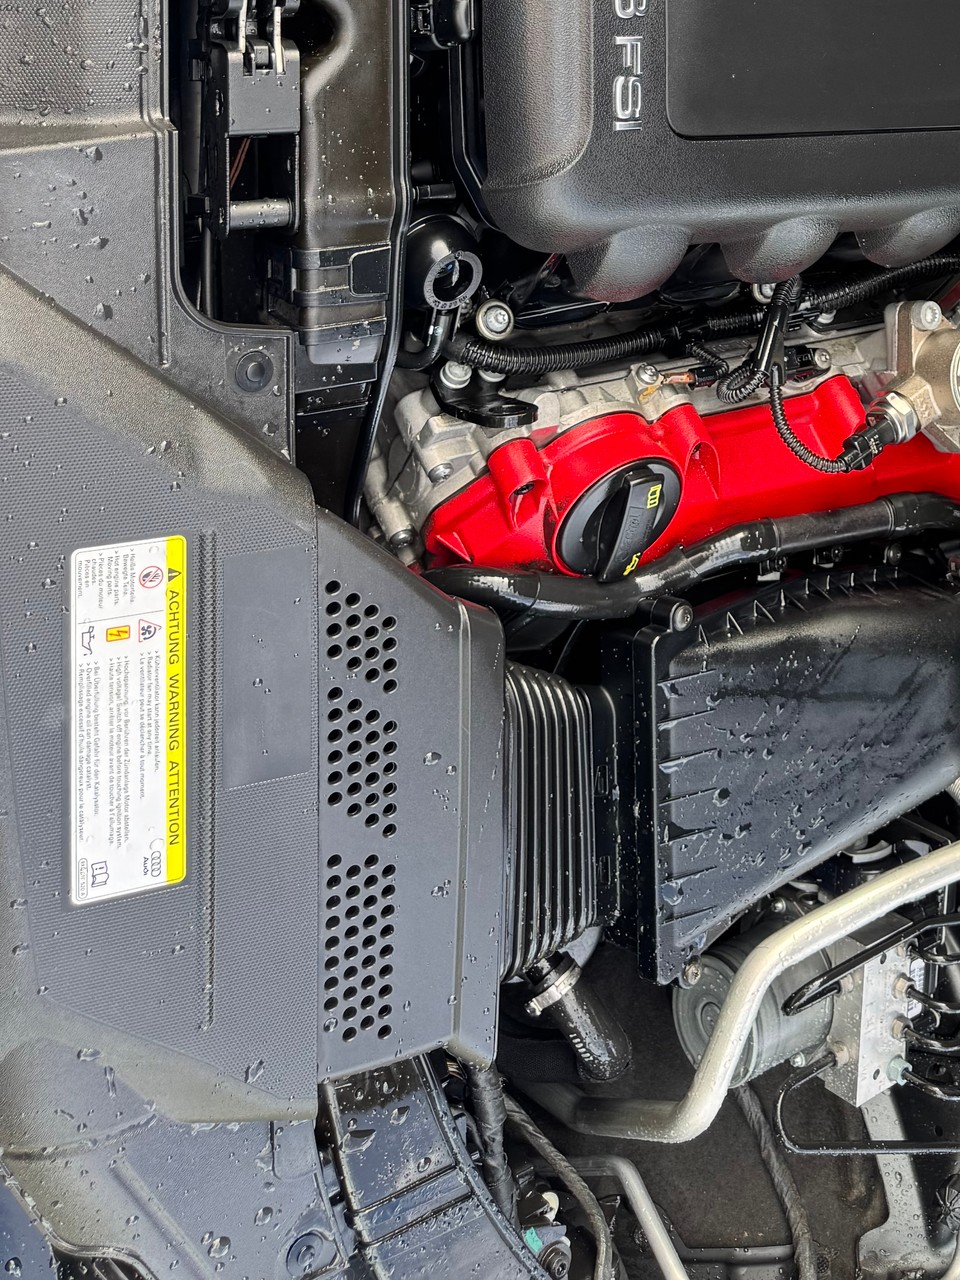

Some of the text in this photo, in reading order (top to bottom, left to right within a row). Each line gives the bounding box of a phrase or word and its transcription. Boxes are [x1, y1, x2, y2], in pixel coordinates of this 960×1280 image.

[612, 36, 644, 131] FSI
[169, 589, 180, 846] ACHTUNG WARNING ATTENTION
